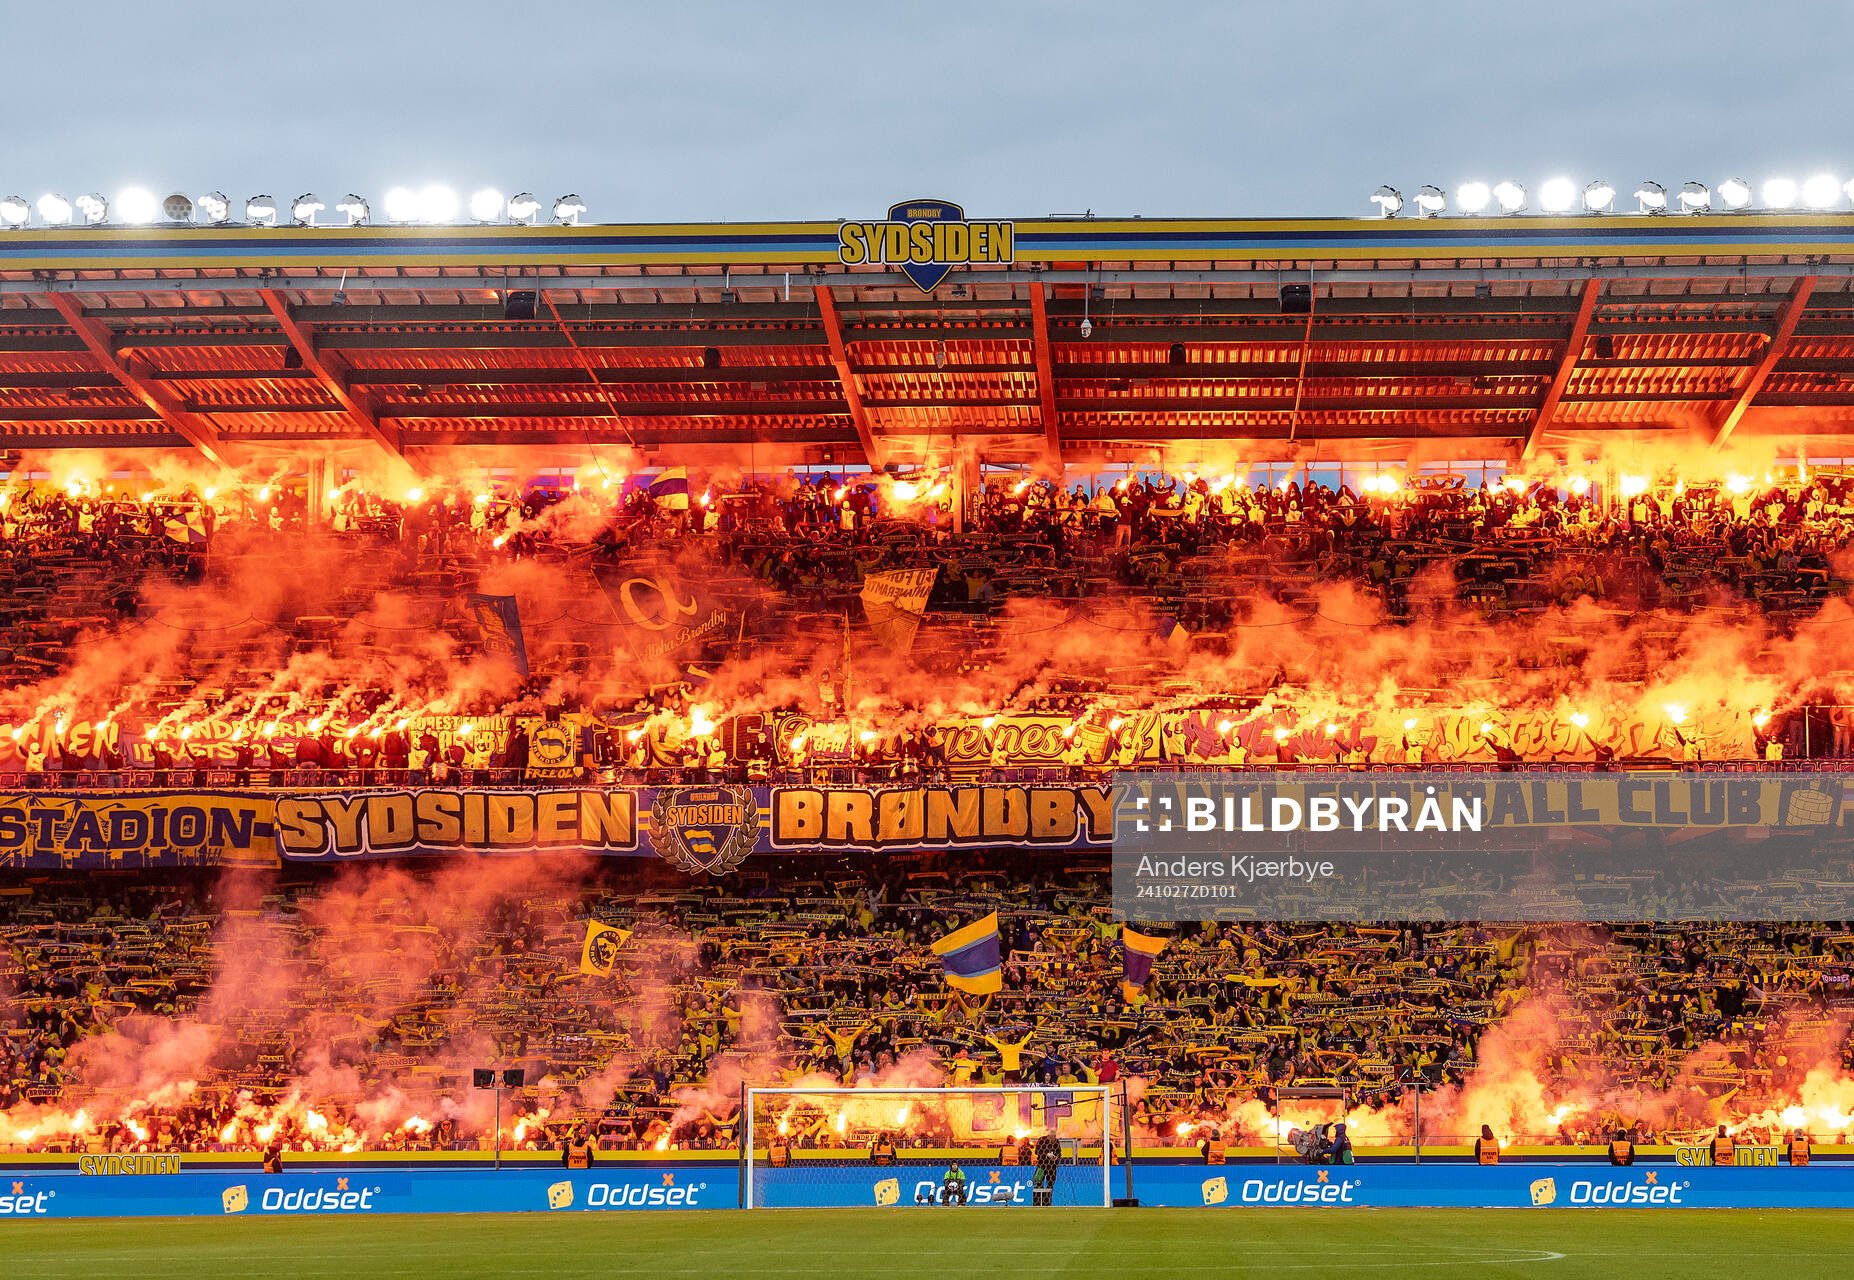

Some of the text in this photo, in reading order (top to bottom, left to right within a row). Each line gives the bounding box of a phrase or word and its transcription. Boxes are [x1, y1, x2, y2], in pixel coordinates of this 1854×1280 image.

[839, 222, 1014, 264] SYDSIDEN
[274, 791, 636, 853] SYDSIDEN
[666, 804, 744, 827] SYDSIDEN
[774, 788, 1131, 844] BRØNDBY
[1616, 780, 1762, 826] CLUB
[79, 1155, 179, 1175] SYDSIDEN
